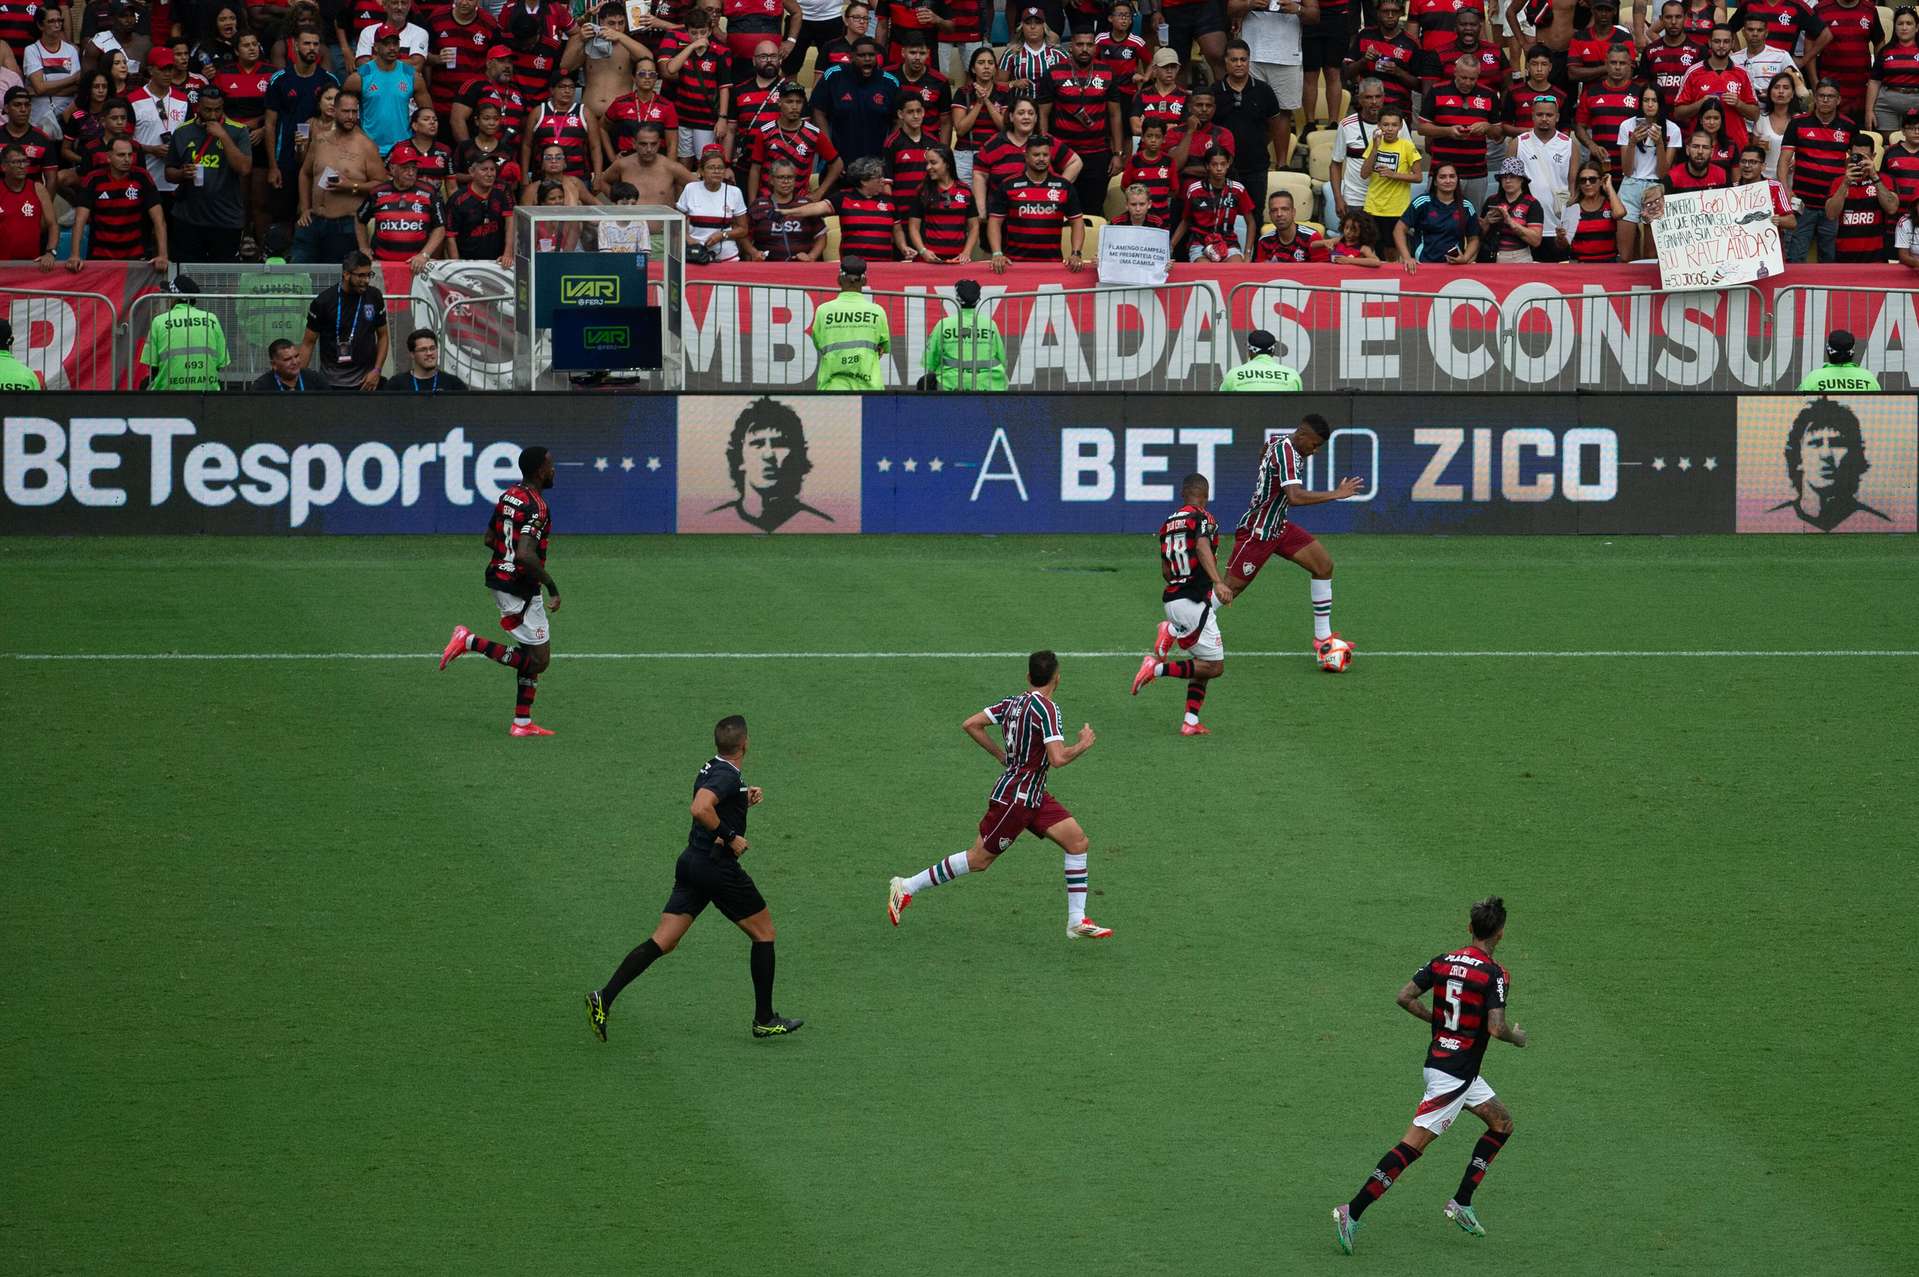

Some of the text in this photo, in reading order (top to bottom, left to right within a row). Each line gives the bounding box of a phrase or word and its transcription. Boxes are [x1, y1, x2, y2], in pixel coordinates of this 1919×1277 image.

[1666, 75, 1684, 87] BR
[1018, 203, 1057, 217] pixbet
[1851, 211, 1875, 225] BRB
[1108, 244, 1139, 252] FLAMENGO
[566, 280, 616, 298] VAR
[165, 317, 217, 331] SUNSET
[825, 312, 879, 325] SUNSET
[587, 330, 625, 345] VAR
[944, 326, 996, 340] SUSET
[184, 361, 203, 369] 693
[841, 355, 860, 365] 828
[1236, 368, 1290, 383] SUNSET
[1817, 378, 1871, 391] SUNSET
[3, 415, 522, 528] BETesporte
[969, 427, 1029, 502] A
[1061, 427, 1233, 502] BET
[1411, 427, 1619, 503] ZICO
[1164, 533, 1192, 577] 18
[1443, 978, 1464, 1031] 5
